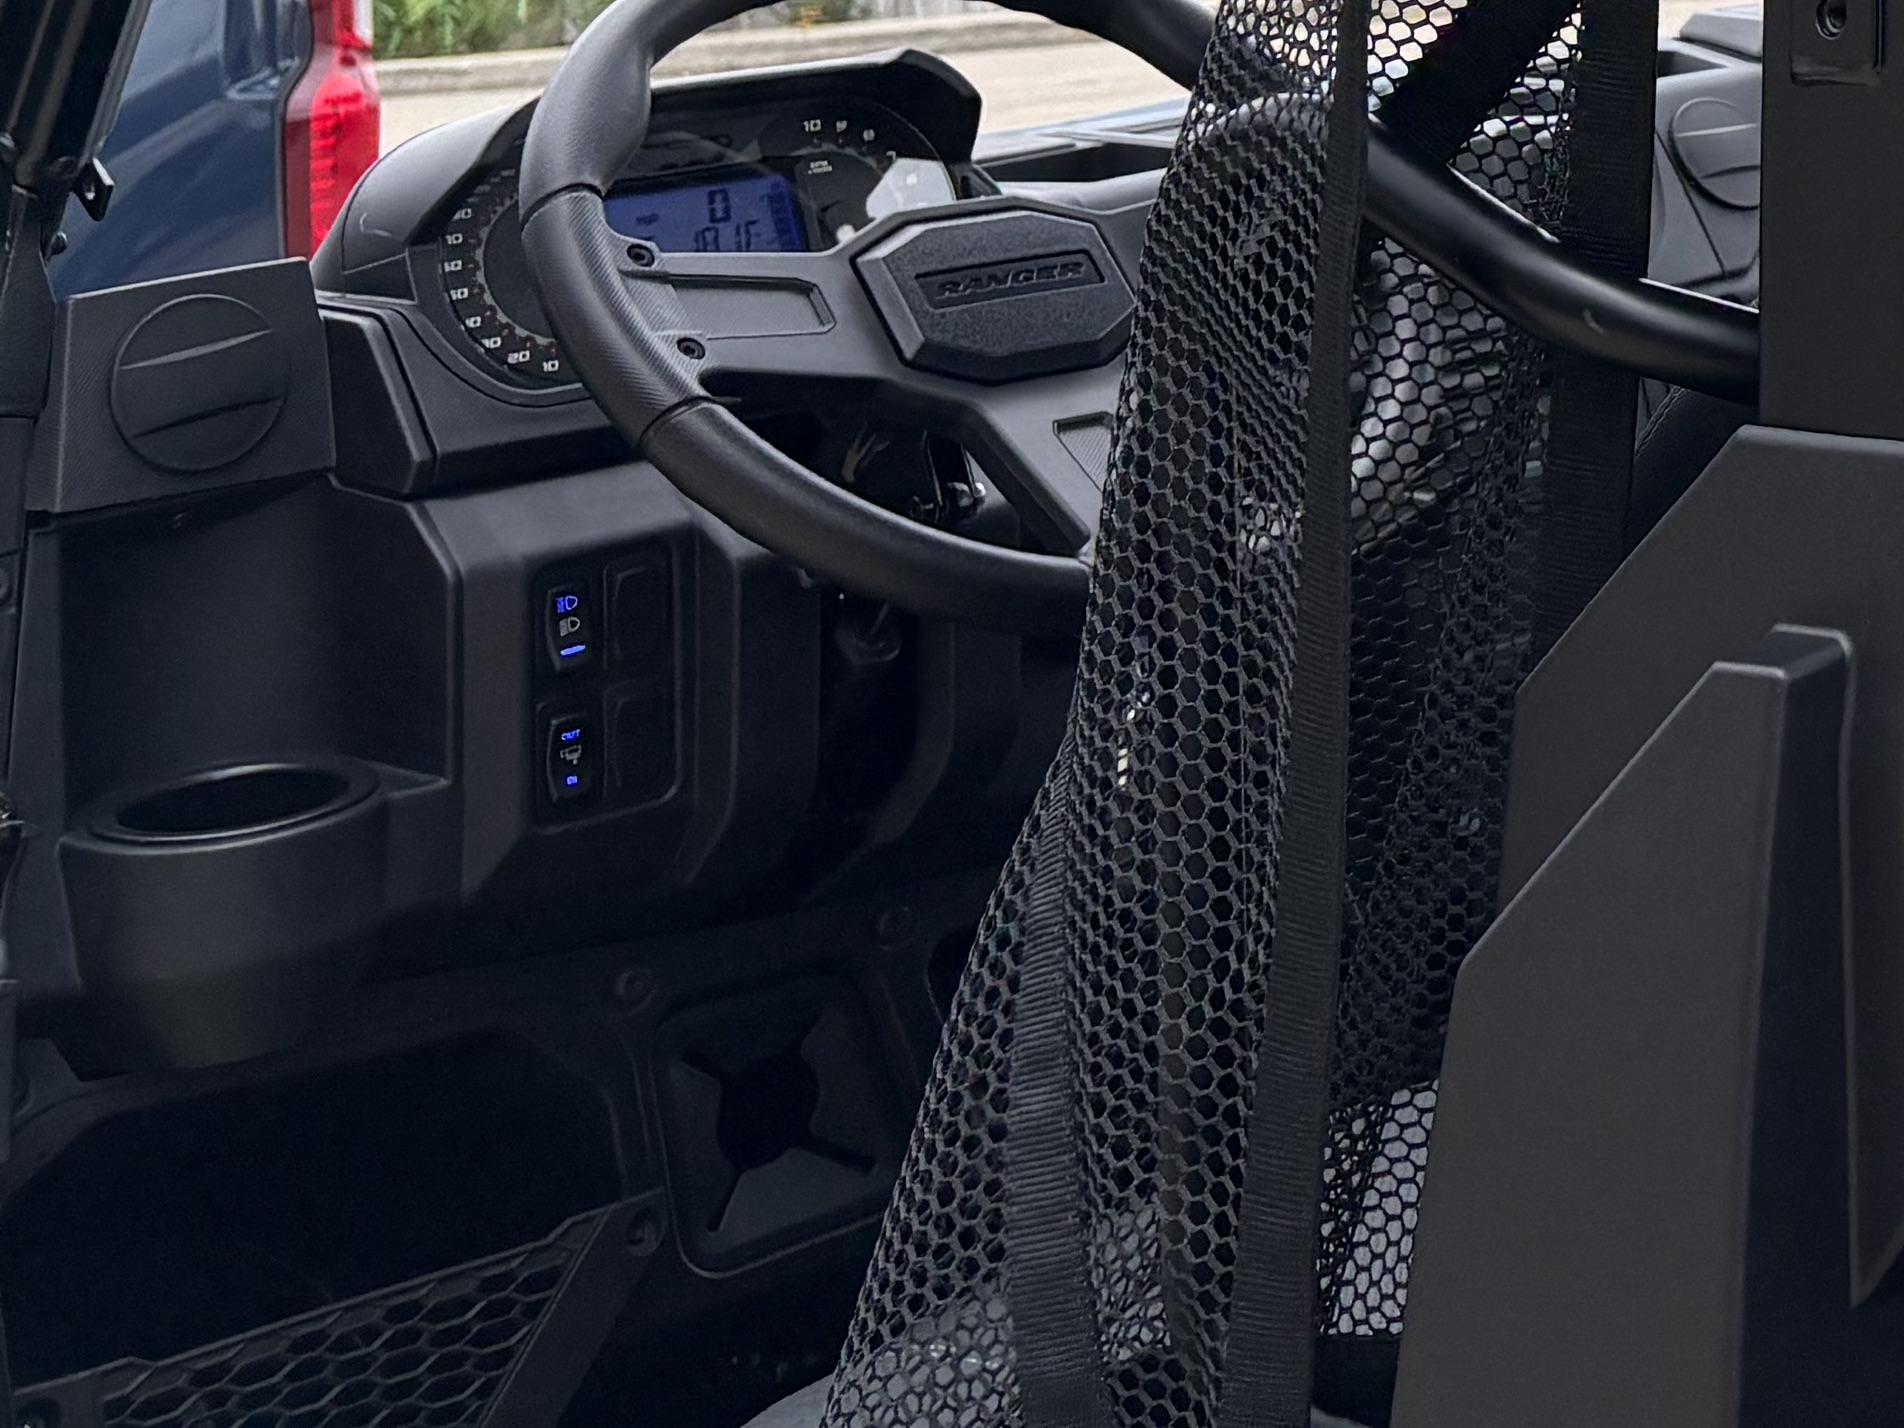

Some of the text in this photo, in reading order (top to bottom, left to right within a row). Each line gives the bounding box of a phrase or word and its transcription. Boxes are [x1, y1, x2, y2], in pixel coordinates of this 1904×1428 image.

[803, 119, 822, 132] 10
[934, 261, 1086, 300] RANGER
[542, 359, 559, 372] 10
